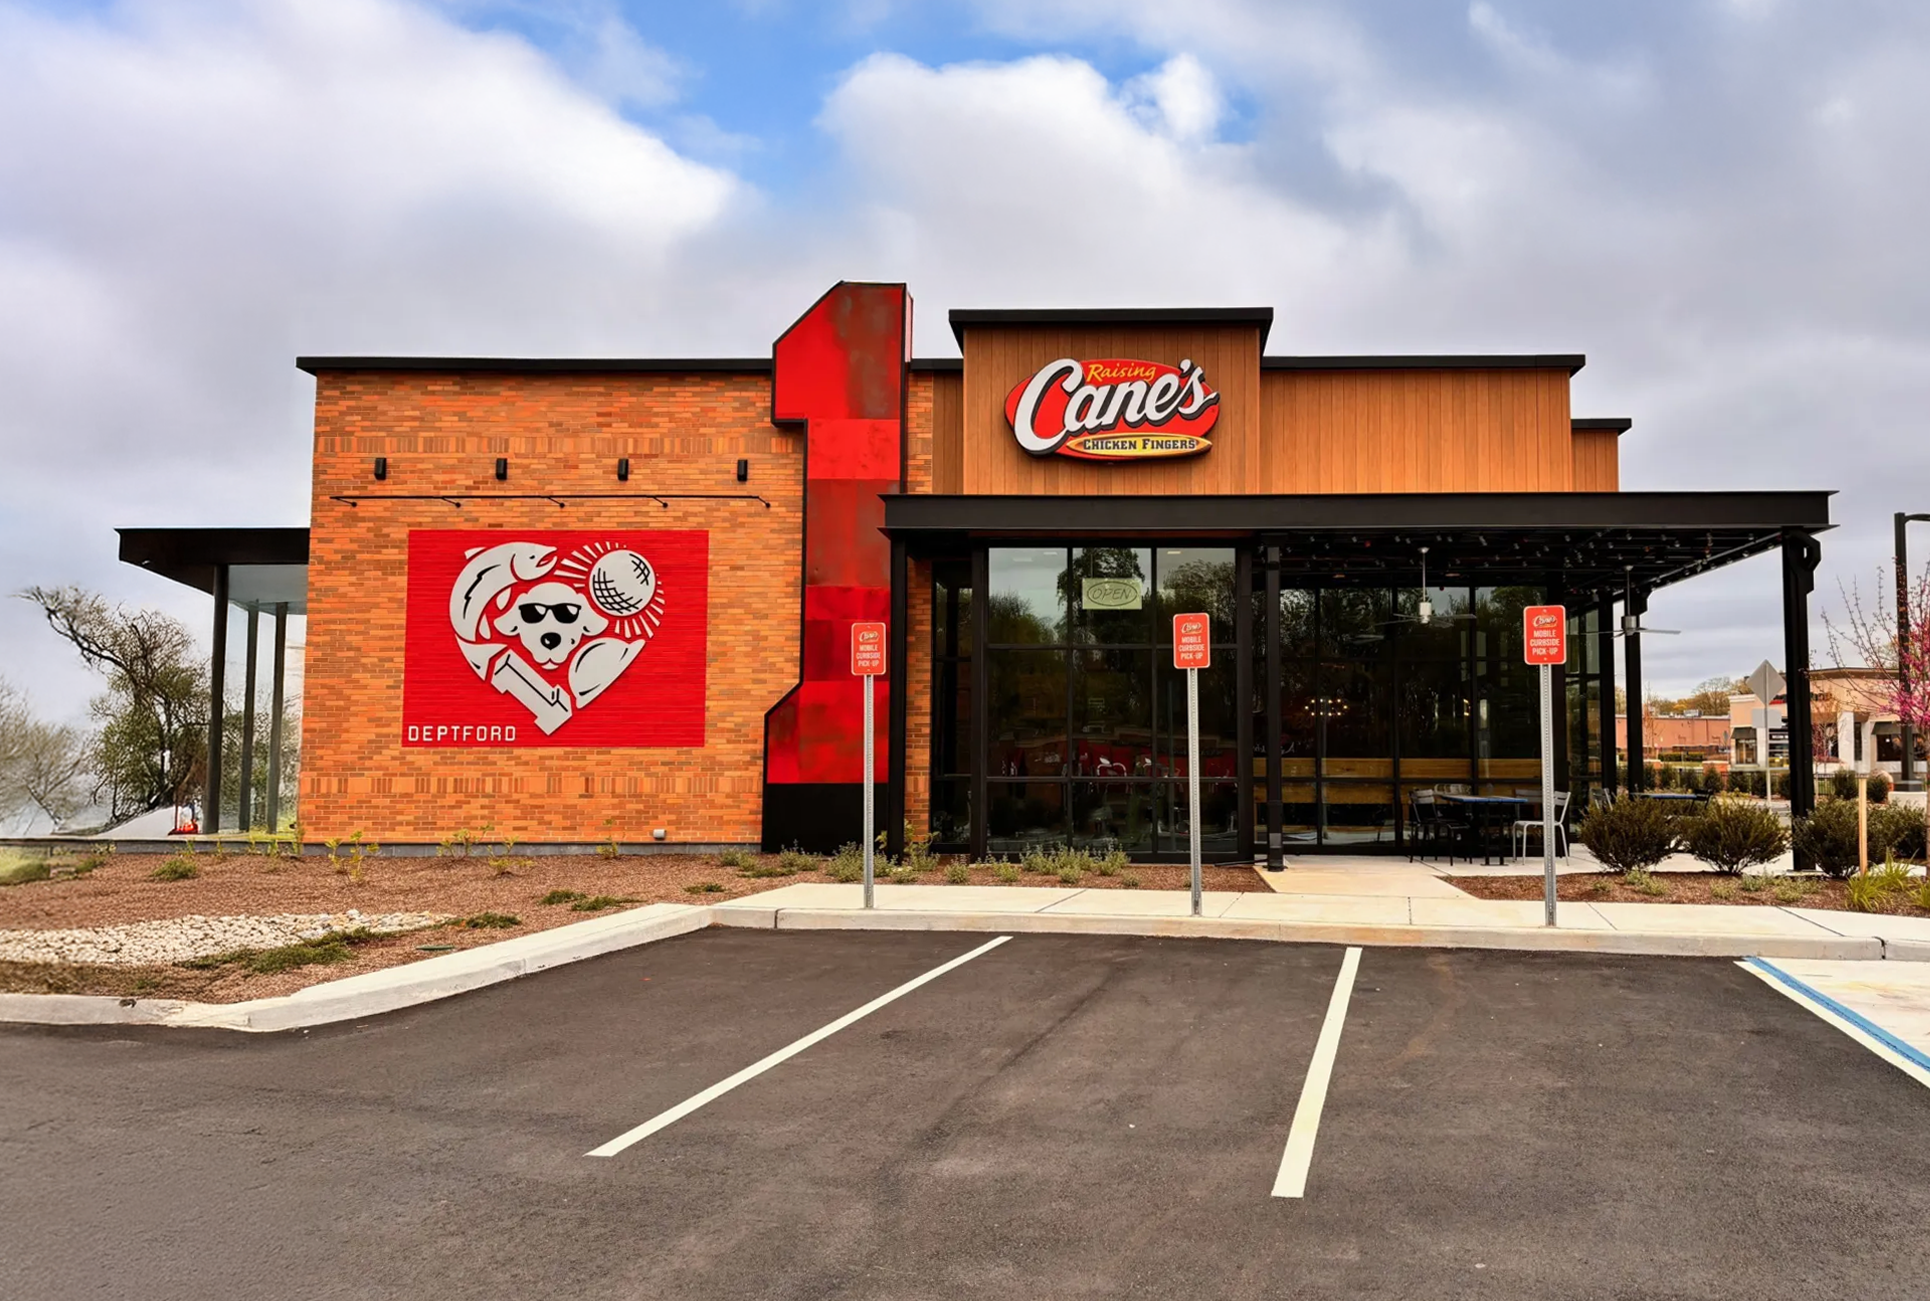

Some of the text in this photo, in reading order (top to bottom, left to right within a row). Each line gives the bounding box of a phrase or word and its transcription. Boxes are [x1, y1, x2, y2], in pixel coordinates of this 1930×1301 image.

[1086, 363, 1156, 382] Raising
[1013, 358, 1219, 453] Cane's
[1083, 437, 1196, 450] CHICKEN FINGERS
[1092, 588, 1131, 600] OPEN
[1533, 630, 1556, 638] MOBILE
[1530, 638, 1560, 647] CURBSIDE
[1178, 644, 1205, 652] CURBSIDE
[1532, 647, 1558, 656] PICK-UP
[856, 652, 881, 660] CURBSIDE
[1180, 652, 1203, 660] PICK-UP
[408, 725, 516, 742] DEPTFORD
